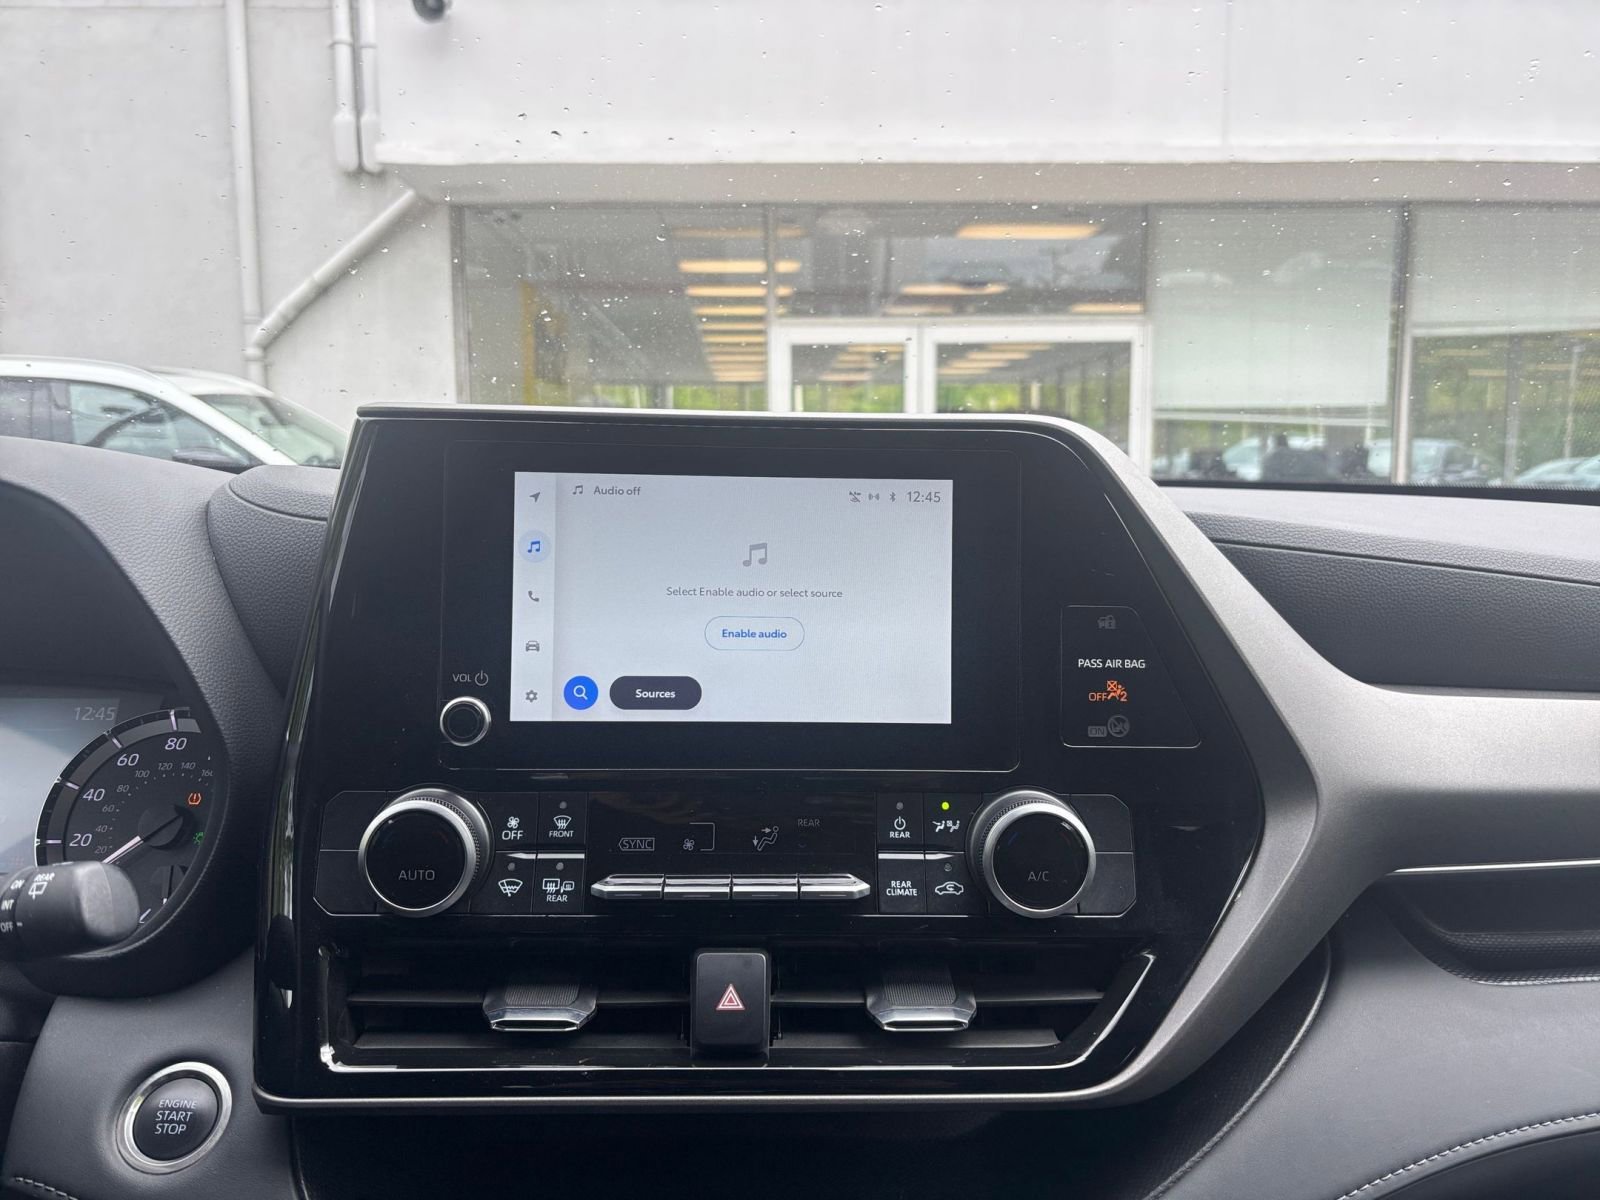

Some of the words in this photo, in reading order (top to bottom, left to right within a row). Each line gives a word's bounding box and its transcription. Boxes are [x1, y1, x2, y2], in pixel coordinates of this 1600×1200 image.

[593, 484, 624, 497] Audio
[625, 484, 641, 497] off
[906, 490, 942, 504] 12:45
[666, 586, 697, 598] Select
[699, 586, 734, 598] Enable
[736, 587, 765, 599] audio
[766, 589, 778, 599] or
[779, 587, 808, 599] select
[810, 589, 843, 599] source
[721, 628, 757, 640] Enable
[758, 628, 787, 640] audio
[1078, 659, 1102, 669] PASS
[1105, 659, 1122, 669] AIR
[1124, 659, 1146, 669] BAG
[452, 673, 472, 682] VOL
[634, 687, 676, 700] Sources
[1088, 692, 1108, 702] OFF
[1120, 691, 1127, 701] 2
[74, 706, 117, 721] 12:45
[164, 737, 188, 751] 80
[116, 753, 140, 767] 60
[158, 762, 173, 771] 120
[181, 762, 196, 771] 140
[134, 770, 150, 778] 100
[116, 784, 130, 793] 80
[83, 788, 106, 803] 40
[102, 804, 115, 813] 60
[798, 818, 820, 827] REAR
[95, 824, 108, 833] 40
[548, 829, 575, 838] FRONT
[69, 833, 92, 847] 20
[501, 829, 524, 841] OFF
[889, 830, 911, 839] REAR
[622, 838, 653, 850] SYNC
[94, 845, 107, 855] 20
[398, 869, 436, 882] AUTO
[1027, 870, 1050, 882] A/C
[891, 880, 912, 889] REAR
[886, 887, 918, 897] CLIMATE
[546, 894, 568, 903] REAR
[158, 1099, 197, 1110] ENGINE
[155, 1110, 193, 1122] START
[154, 1123, 187, 1135] STOP
